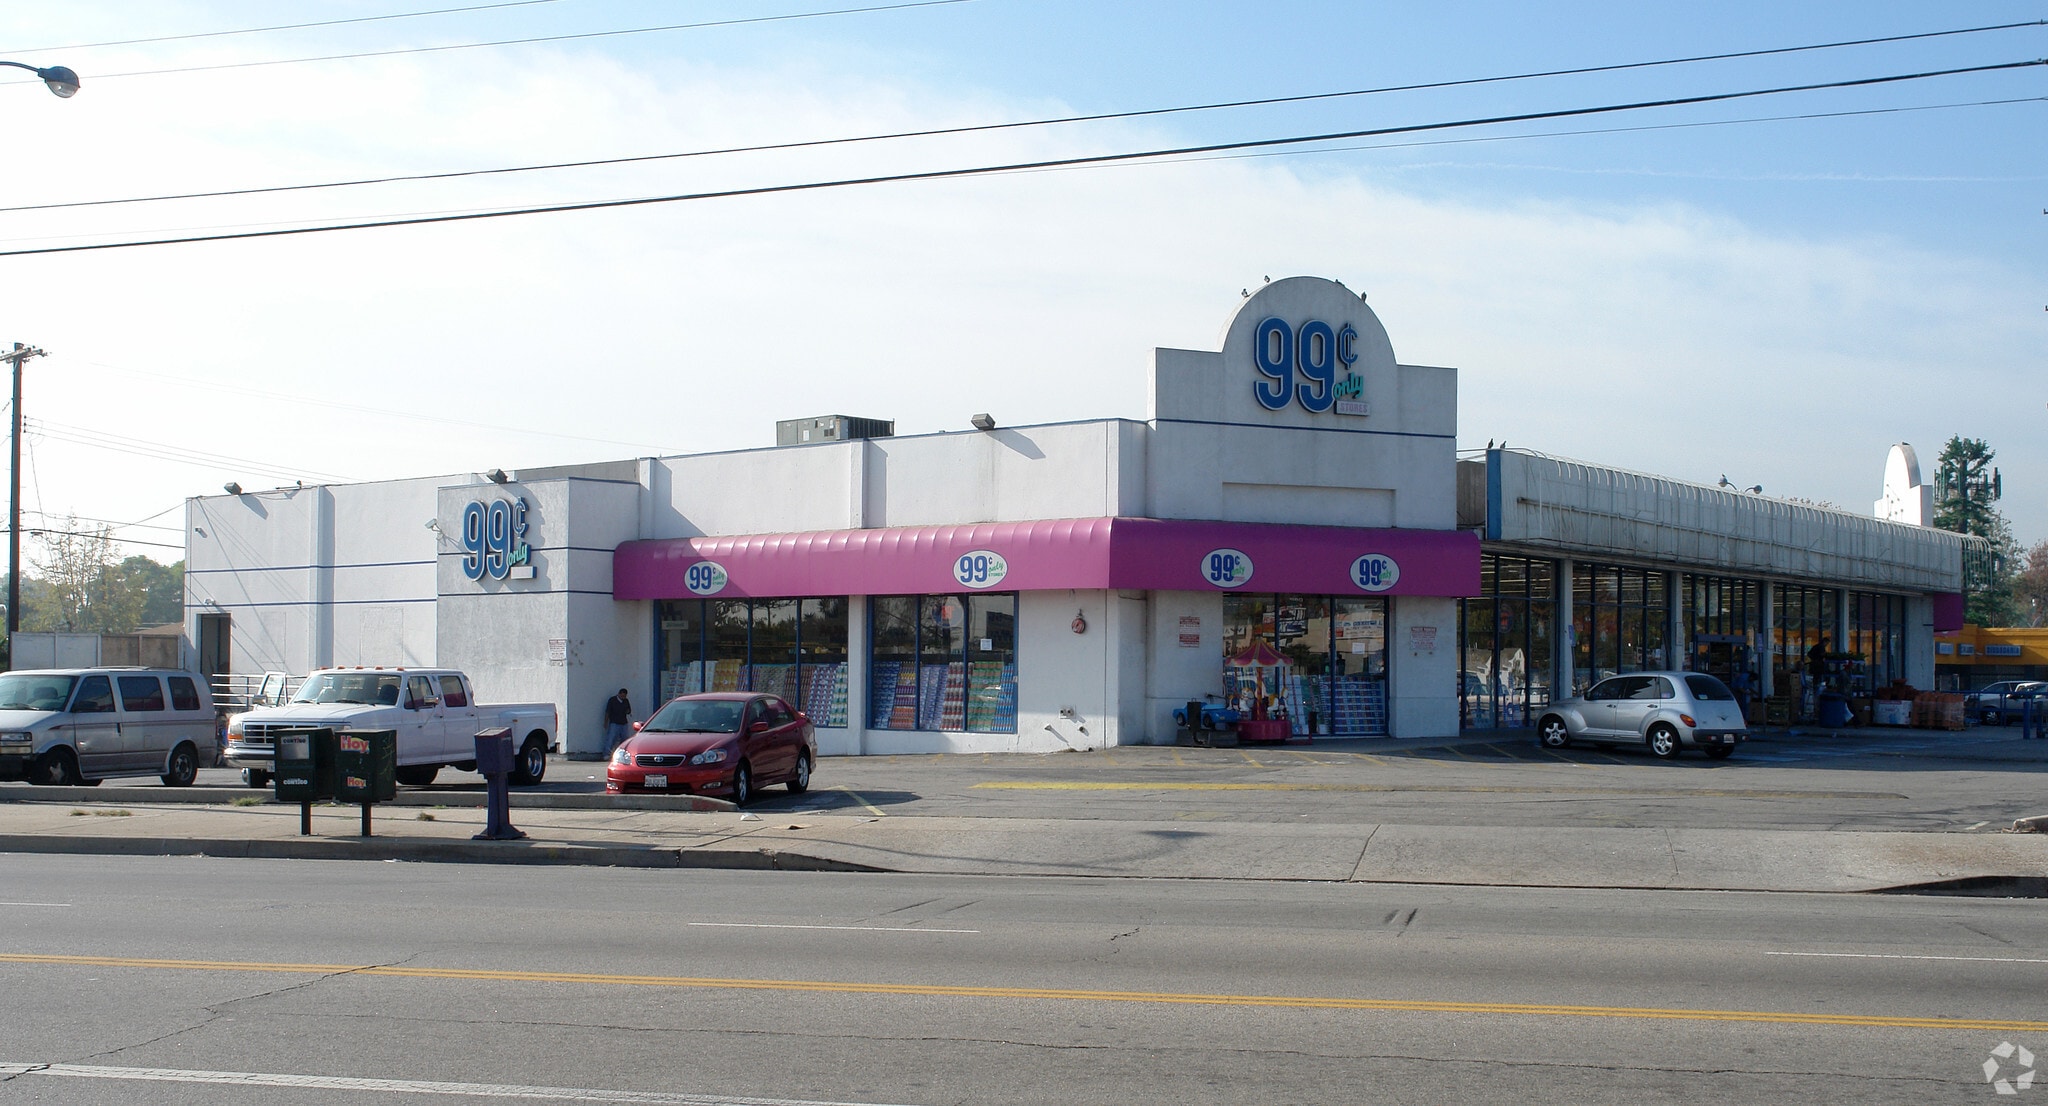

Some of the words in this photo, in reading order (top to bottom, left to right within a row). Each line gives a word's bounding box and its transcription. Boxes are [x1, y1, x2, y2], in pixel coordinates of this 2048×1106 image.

[1333, 372, 1364, 399] only
[1340, 402, 1368, 414] STORES
[508, 541, 528, 566] only
[341, 735, 369, 755] Hoy
[347, 776, 366, 789] Hoy
